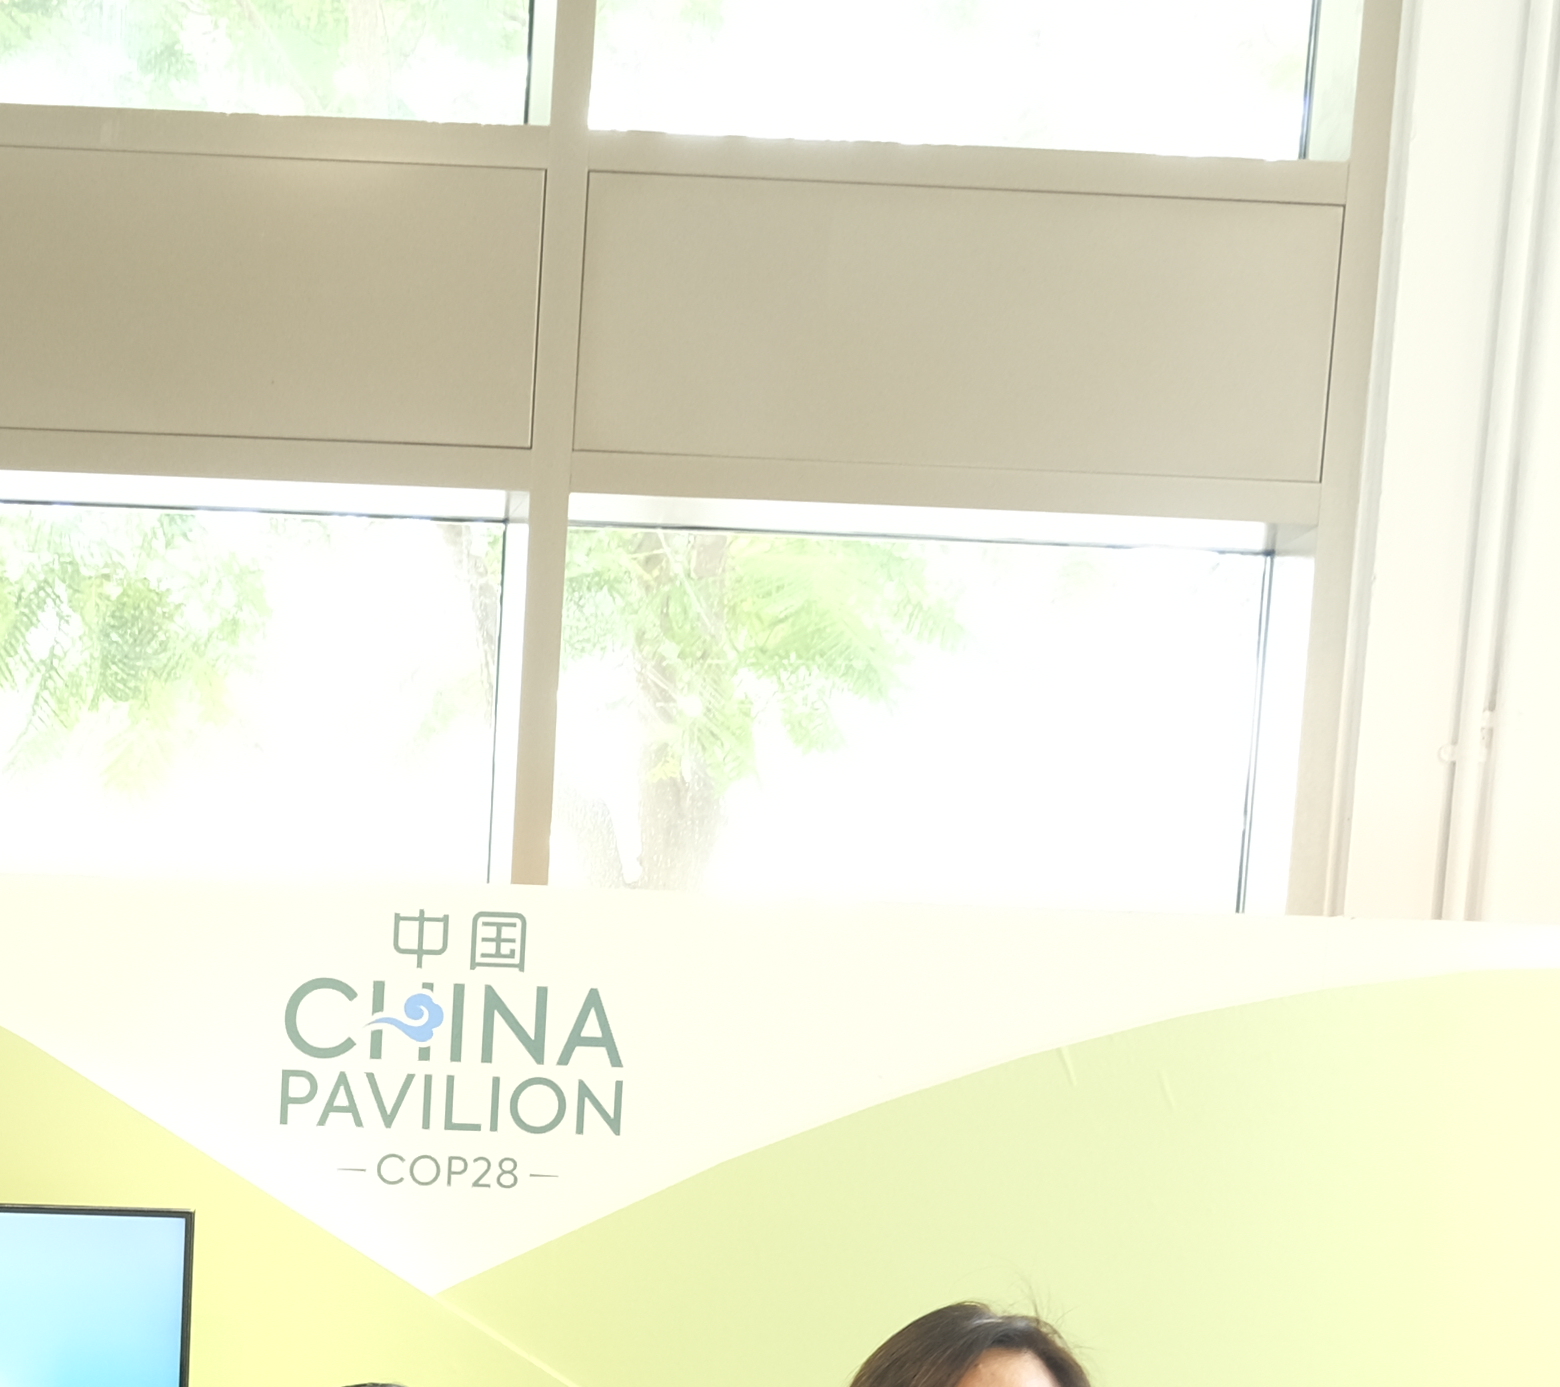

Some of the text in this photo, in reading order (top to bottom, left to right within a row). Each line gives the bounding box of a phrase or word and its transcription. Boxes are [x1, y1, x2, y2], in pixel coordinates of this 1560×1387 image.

[393, 909, 527, 972] 中国
[284, 977, 623, 1067] CHINA
[280, 1069, 623, 1136] PAVILION
[377, 1153, 518, 1188] COP28
